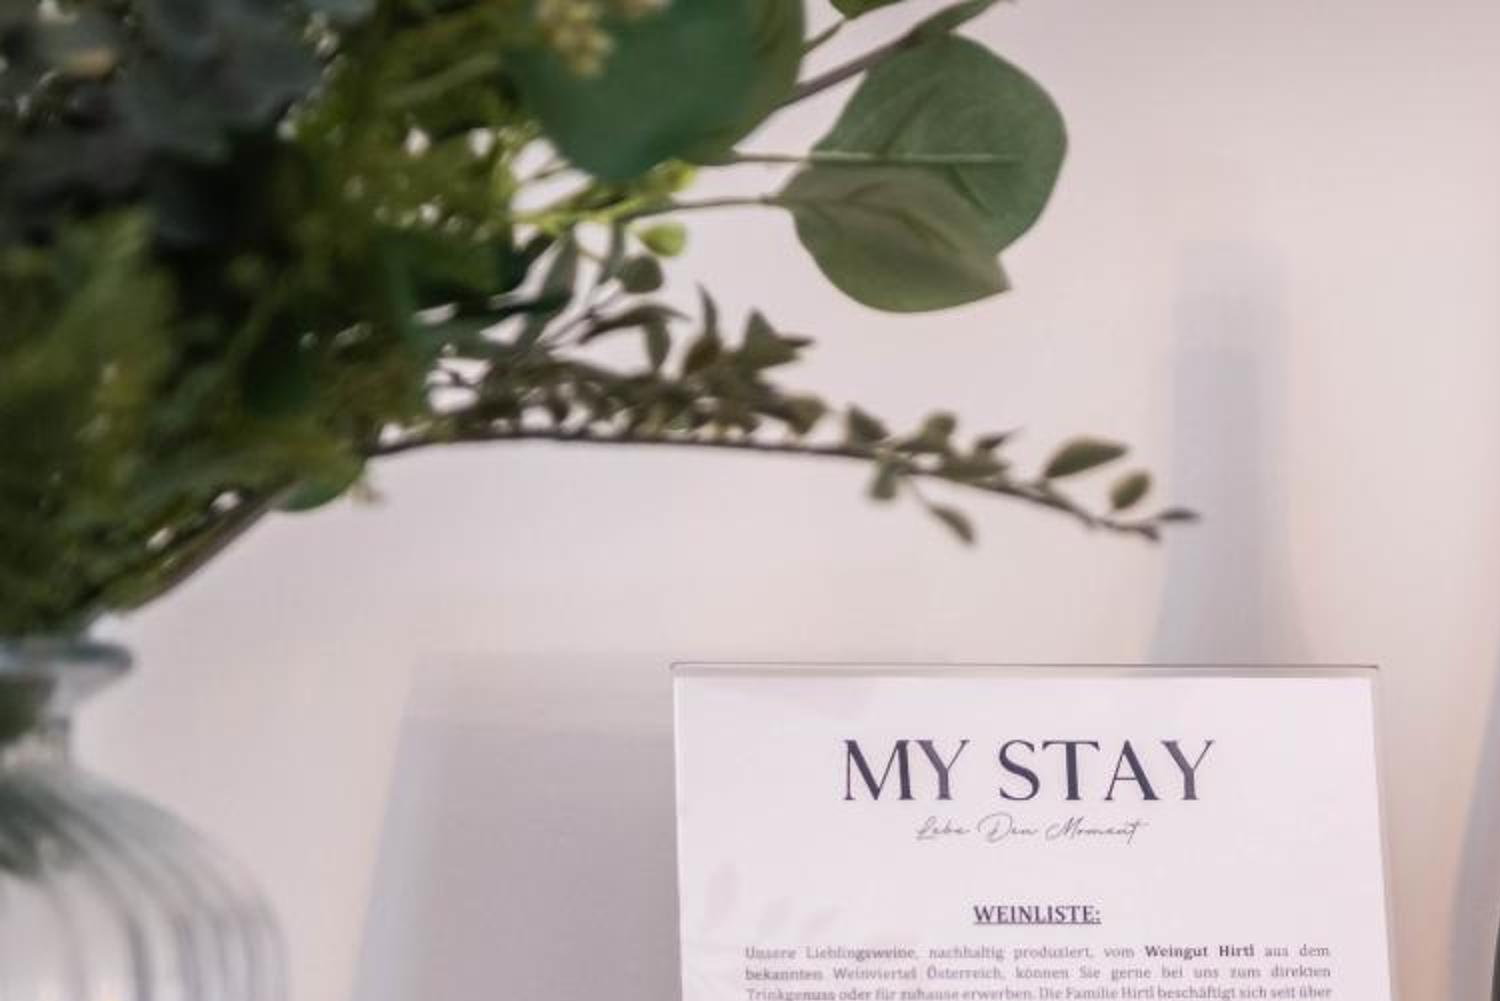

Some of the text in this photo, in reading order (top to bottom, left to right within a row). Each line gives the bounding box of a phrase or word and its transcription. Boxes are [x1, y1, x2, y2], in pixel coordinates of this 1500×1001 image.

[842, 739, 1215, 801] MY STAY
[978, 812, 1038, 842] Den
[1044, 815, 1147, 845] Moment
[973, 903, 1102, 926] WEINLISTE:
